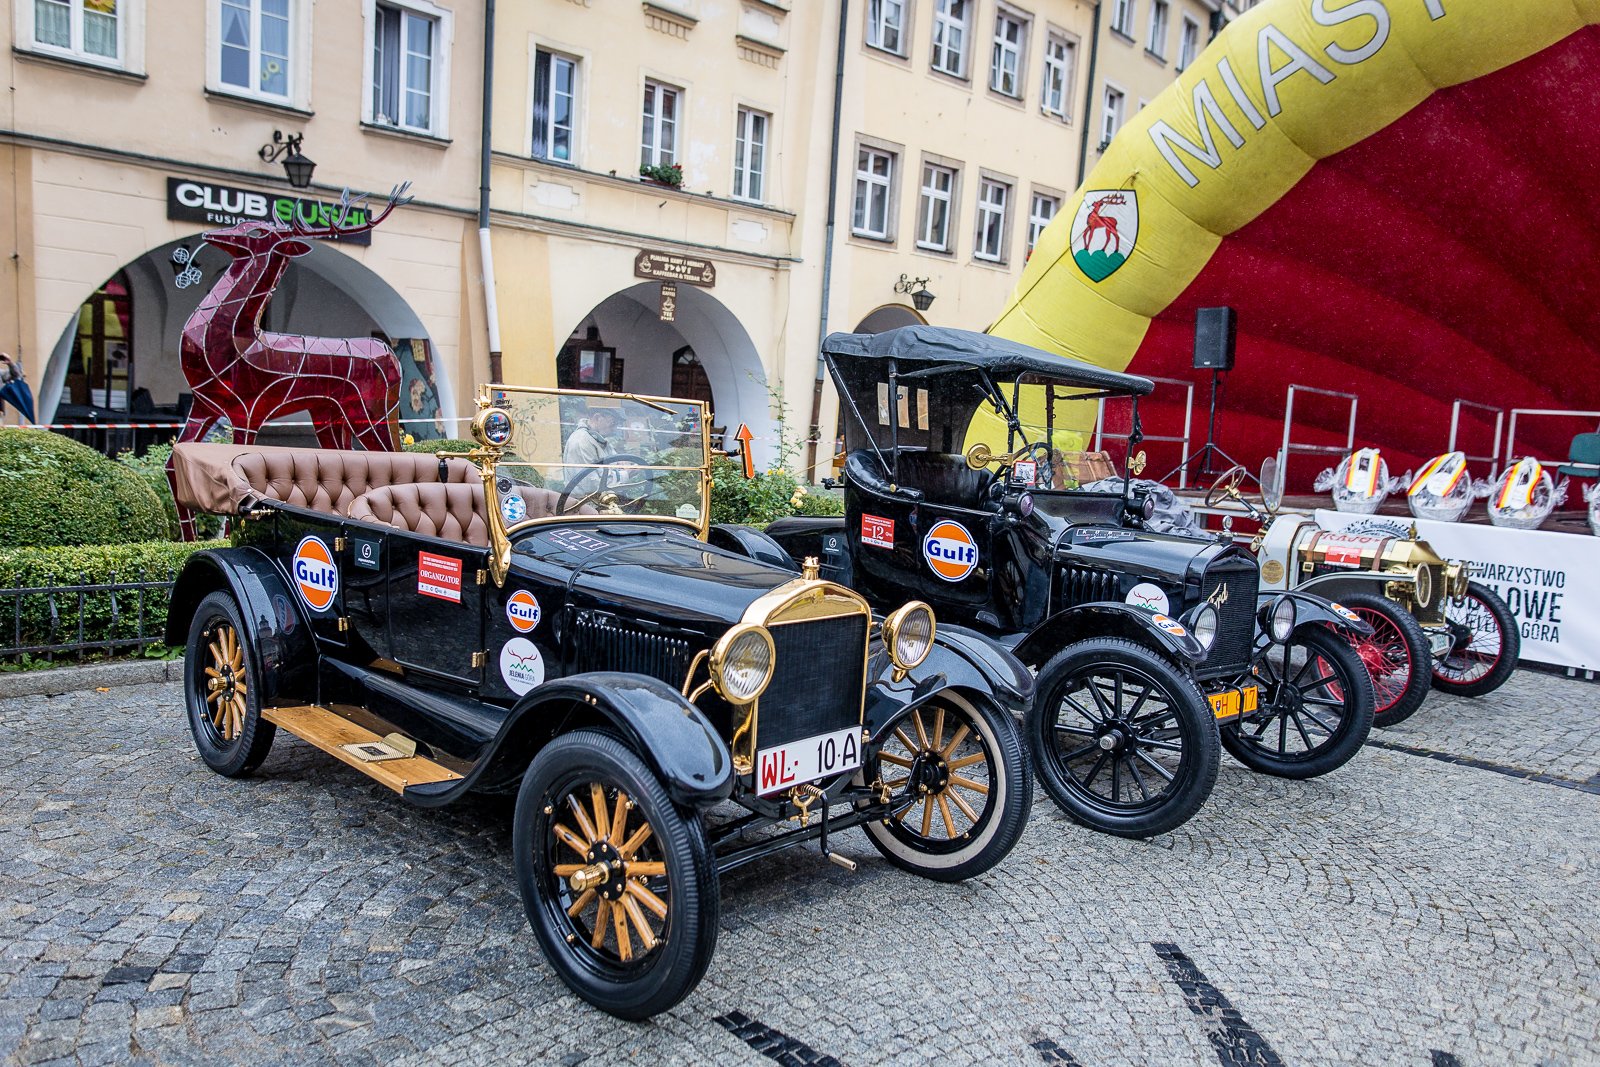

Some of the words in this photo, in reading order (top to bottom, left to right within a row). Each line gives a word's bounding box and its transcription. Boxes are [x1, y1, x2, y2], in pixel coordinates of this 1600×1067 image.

[1147, 0, 1446, 188] MIAS
[175, 183, 268, 217] CLUB
[275, 198, 366, 229] SUSHI
[872, 525, 884, 540] 12
[927, 540, 975, 563] Gulf
[1339, 551, 1348, 562] 7
[296, 561, 336, 589] Gulf
[420, 569, 460, 585] ORGANIZATOR
[509, 602, 538, 620] Gulf
[1521, 618, 1560, 643] GÓRA
